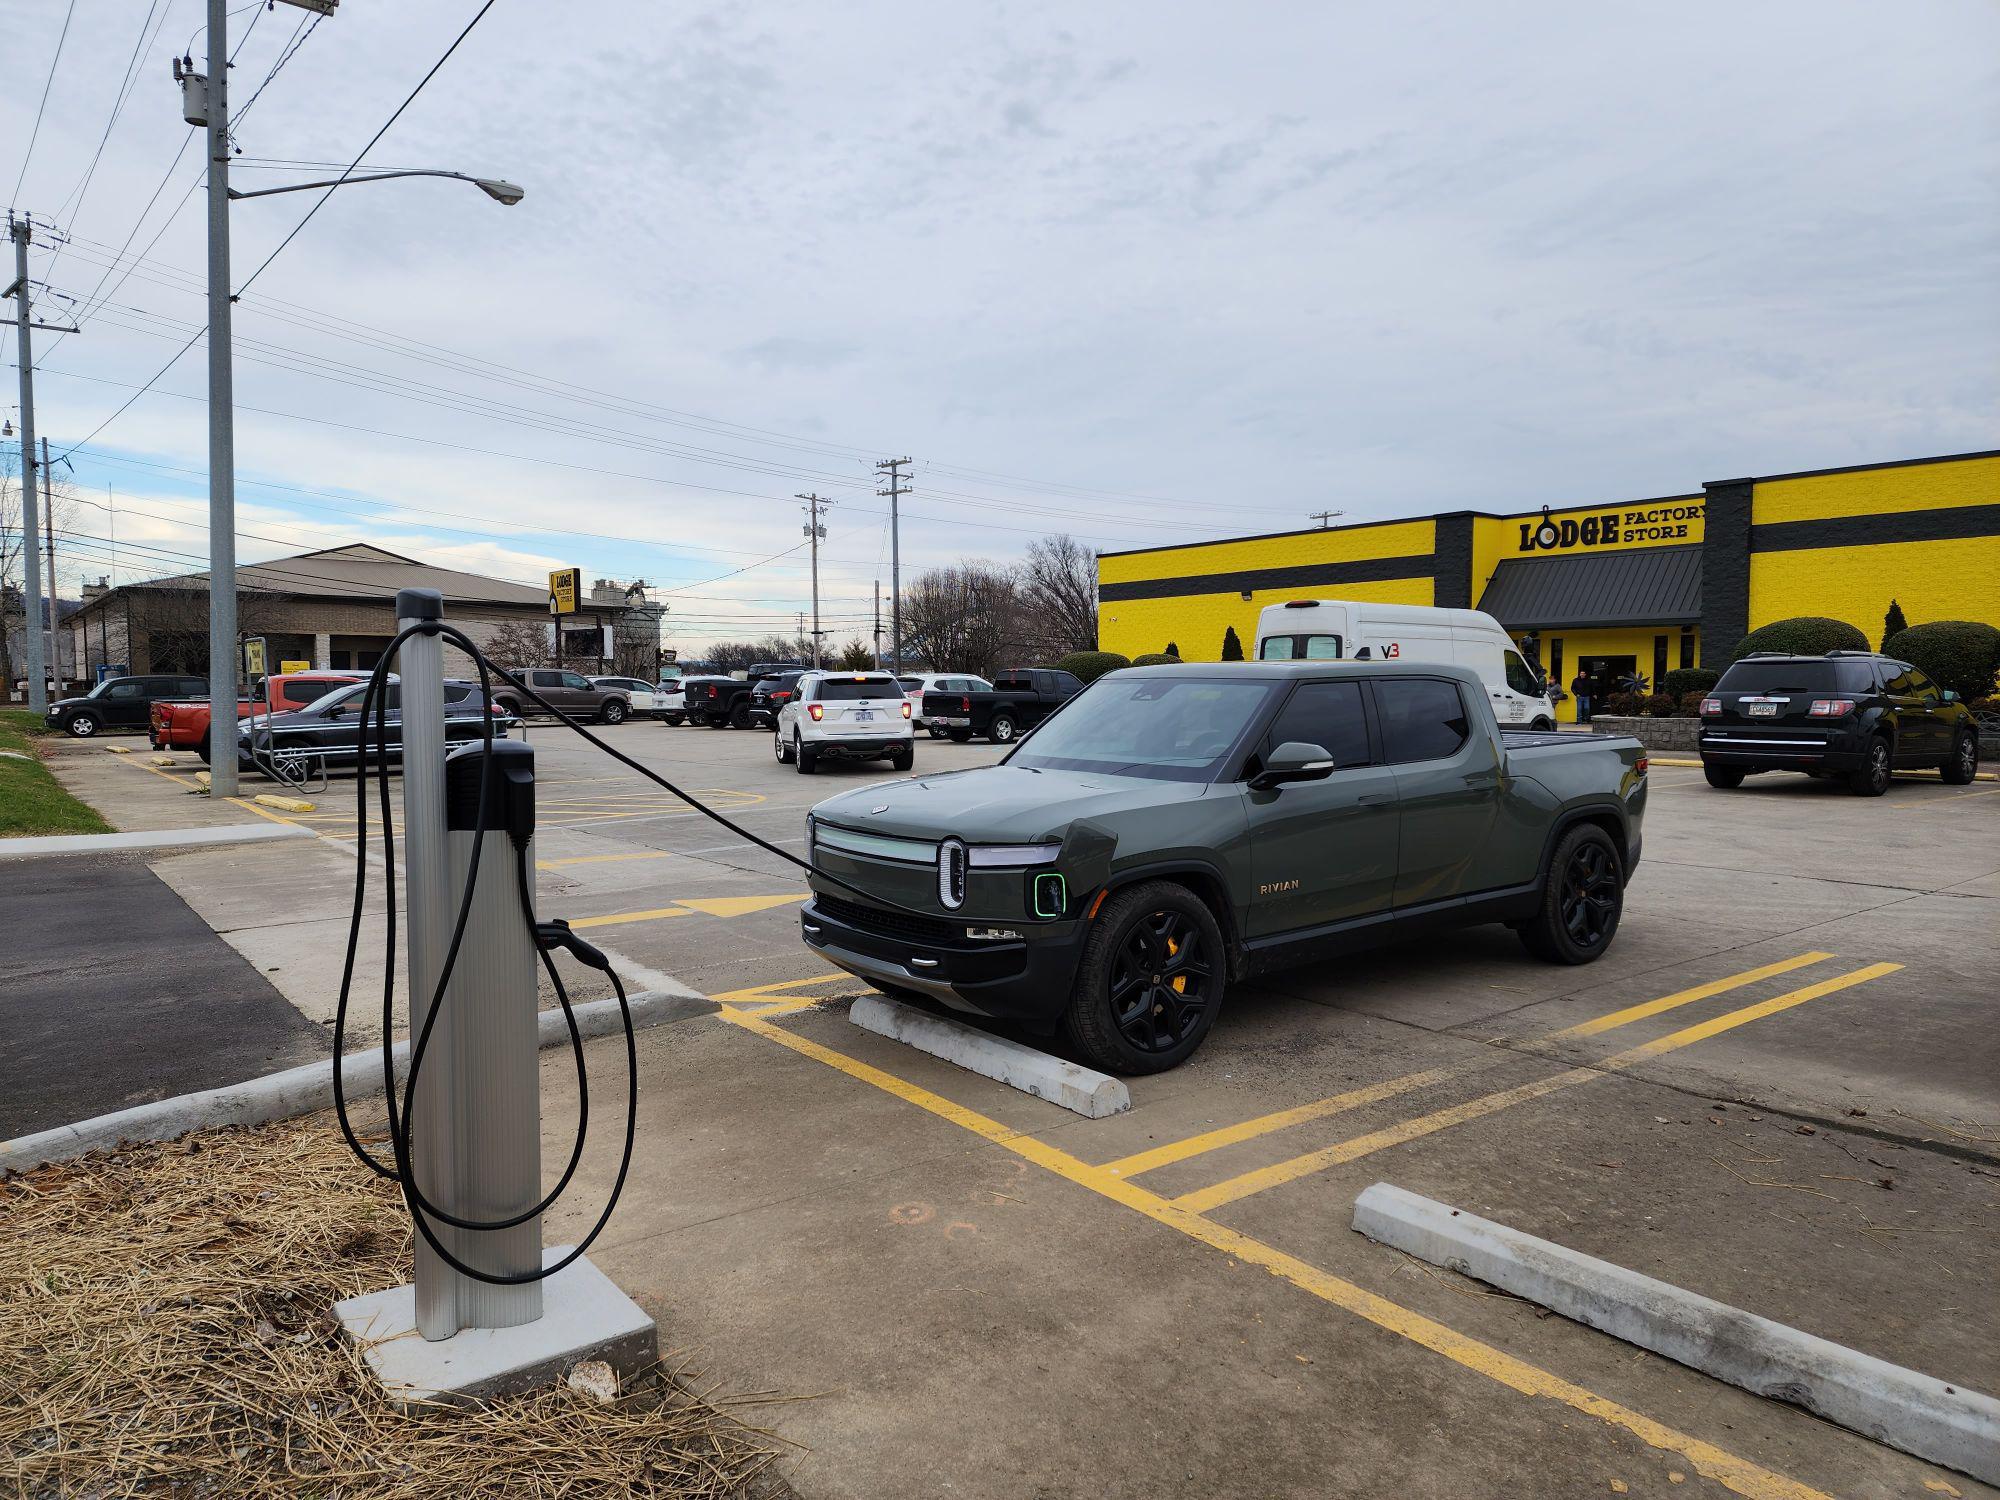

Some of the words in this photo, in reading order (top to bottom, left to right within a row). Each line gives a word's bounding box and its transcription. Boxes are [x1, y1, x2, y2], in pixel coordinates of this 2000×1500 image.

[1519, 506, 1620, 551] LODGE
[1623, 525, 1688, 543] STORE
[1260, 879, 1300, 895] RIVIAN
